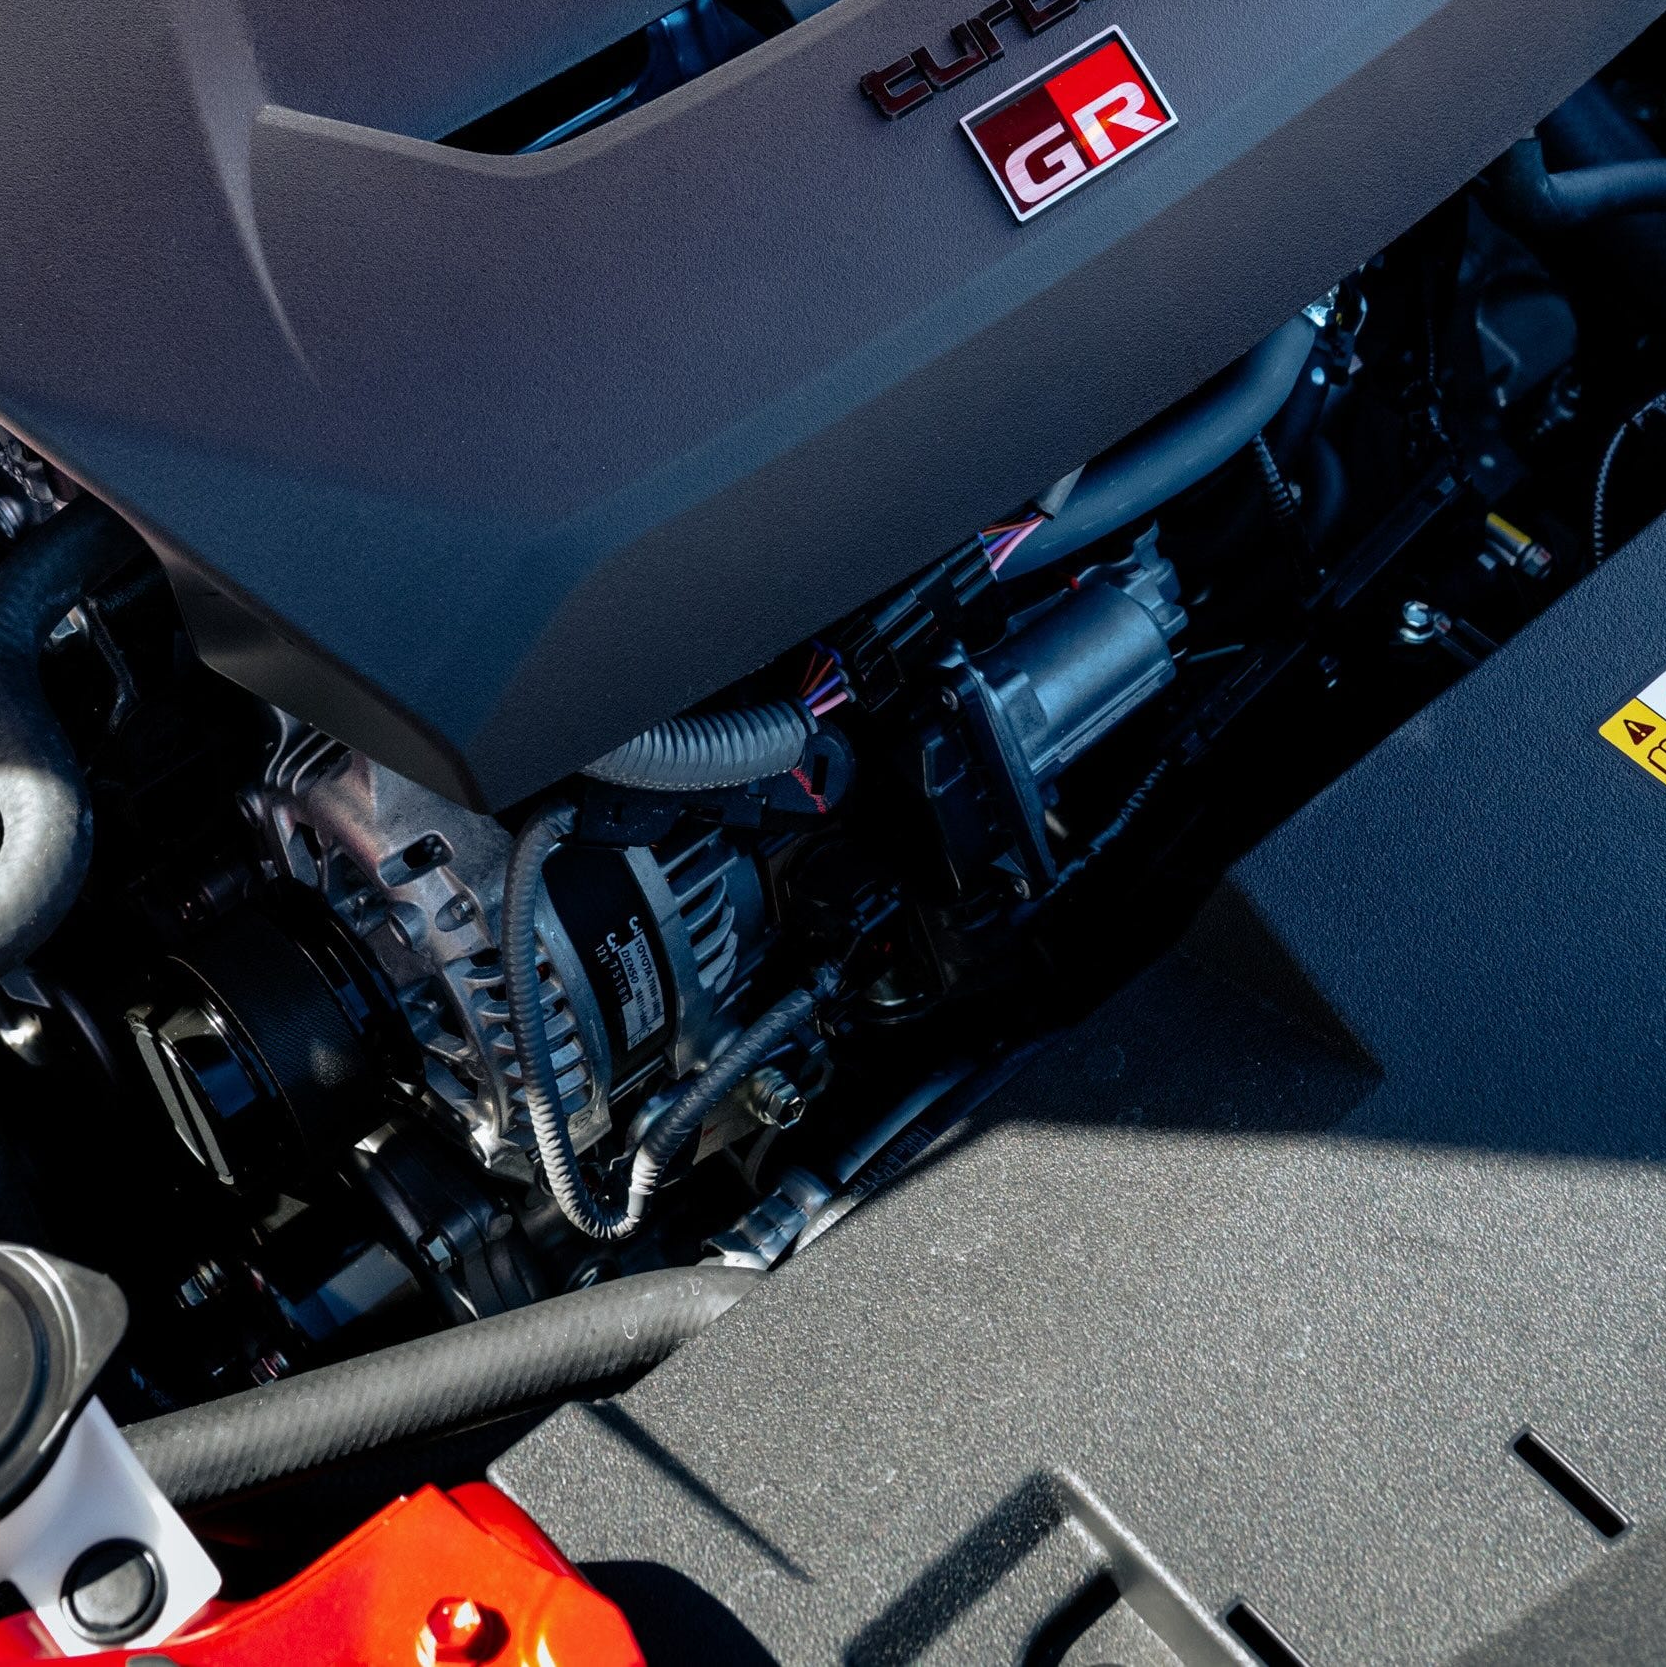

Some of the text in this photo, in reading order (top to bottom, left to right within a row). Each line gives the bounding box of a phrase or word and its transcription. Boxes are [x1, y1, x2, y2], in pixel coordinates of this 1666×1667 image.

[1004, 80, 1164, 204] GR
[620, 949, 640, 985] DENSO
[634, 938, 654, 979] TOYOTA
